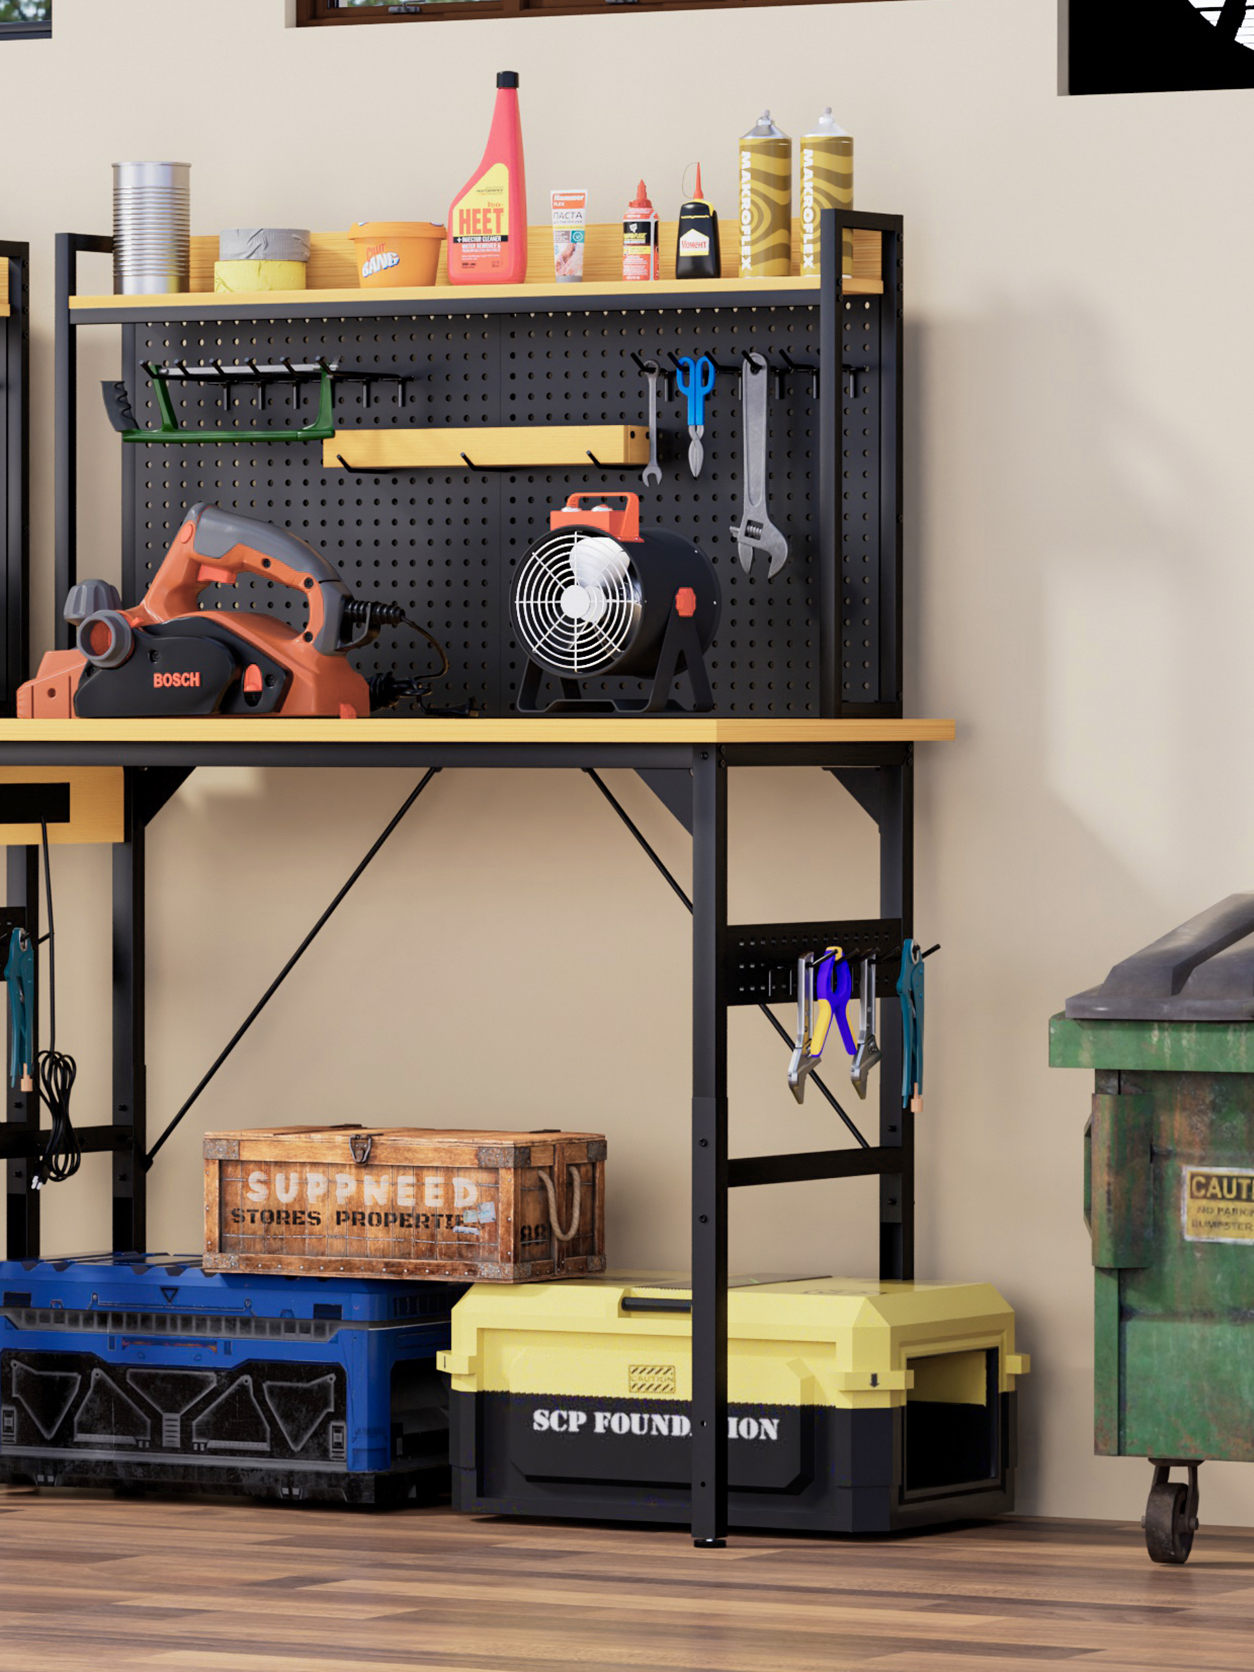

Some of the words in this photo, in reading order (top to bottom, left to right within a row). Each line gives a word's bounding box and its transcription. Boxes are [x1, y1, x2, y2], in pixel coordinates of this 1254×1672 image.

[553, 211, 583, 219] ПАСТА
[741, 151, 752, 271] MAKROFLEX
[803, 149, 814, 269] MAKROFLEX
[459, 208, 504, 235] HEET
[681, 240, 707, 249] Момент
[362, 252, 400, 277] BANG
[153, 672, 201, 688] BOSCH
[246, 1170, 479, 1208] SUPPNEED
[230, 1208, 322, 1226] STORES
[335, 1210, 474, 1230] PROPERTIE
[1197, 1206, 1214, 1214] NO
[1191, 1219, 1253, 1232] DUMPSTER
[630, 1374, 675, 1384] CAUTION
[533, 1409, 587, 1433] SCP
[594, 1411, 779, 1441] FOUNDION
